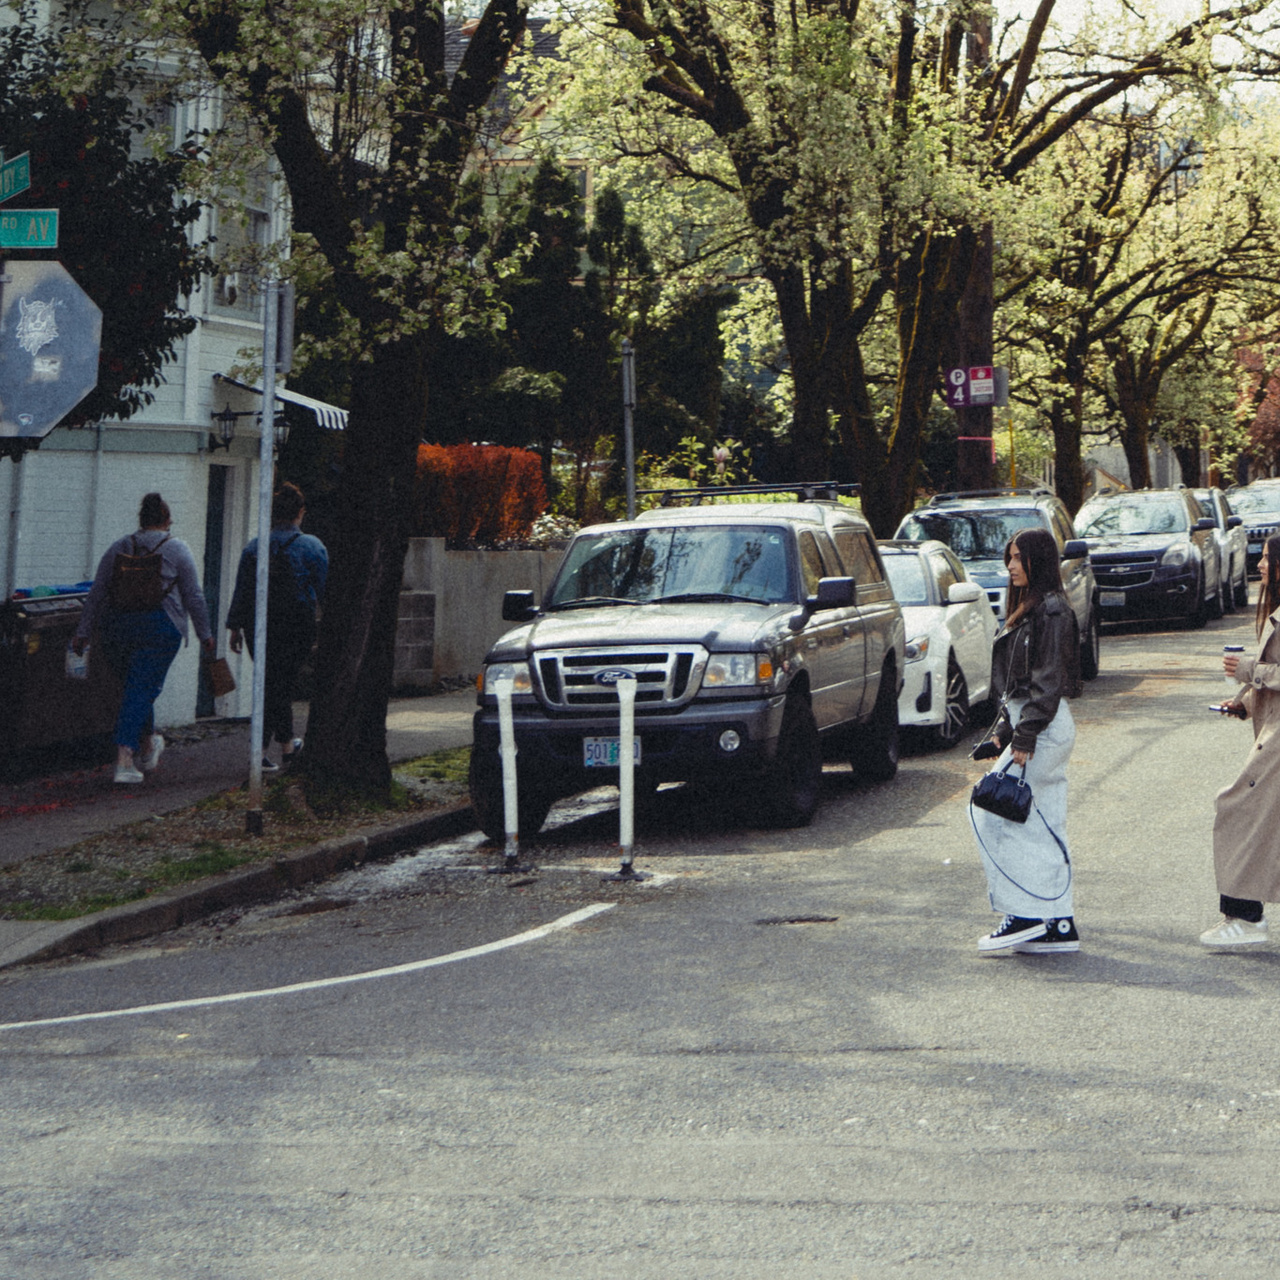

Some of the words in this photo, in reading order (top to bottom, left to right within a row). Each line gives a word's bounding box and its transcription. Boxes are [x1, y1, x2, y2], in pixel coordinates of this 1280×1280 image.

[27, 217, 50, 241] AV
[954, 371, 963, 383] P
[953, 386, 965, 401] 4
